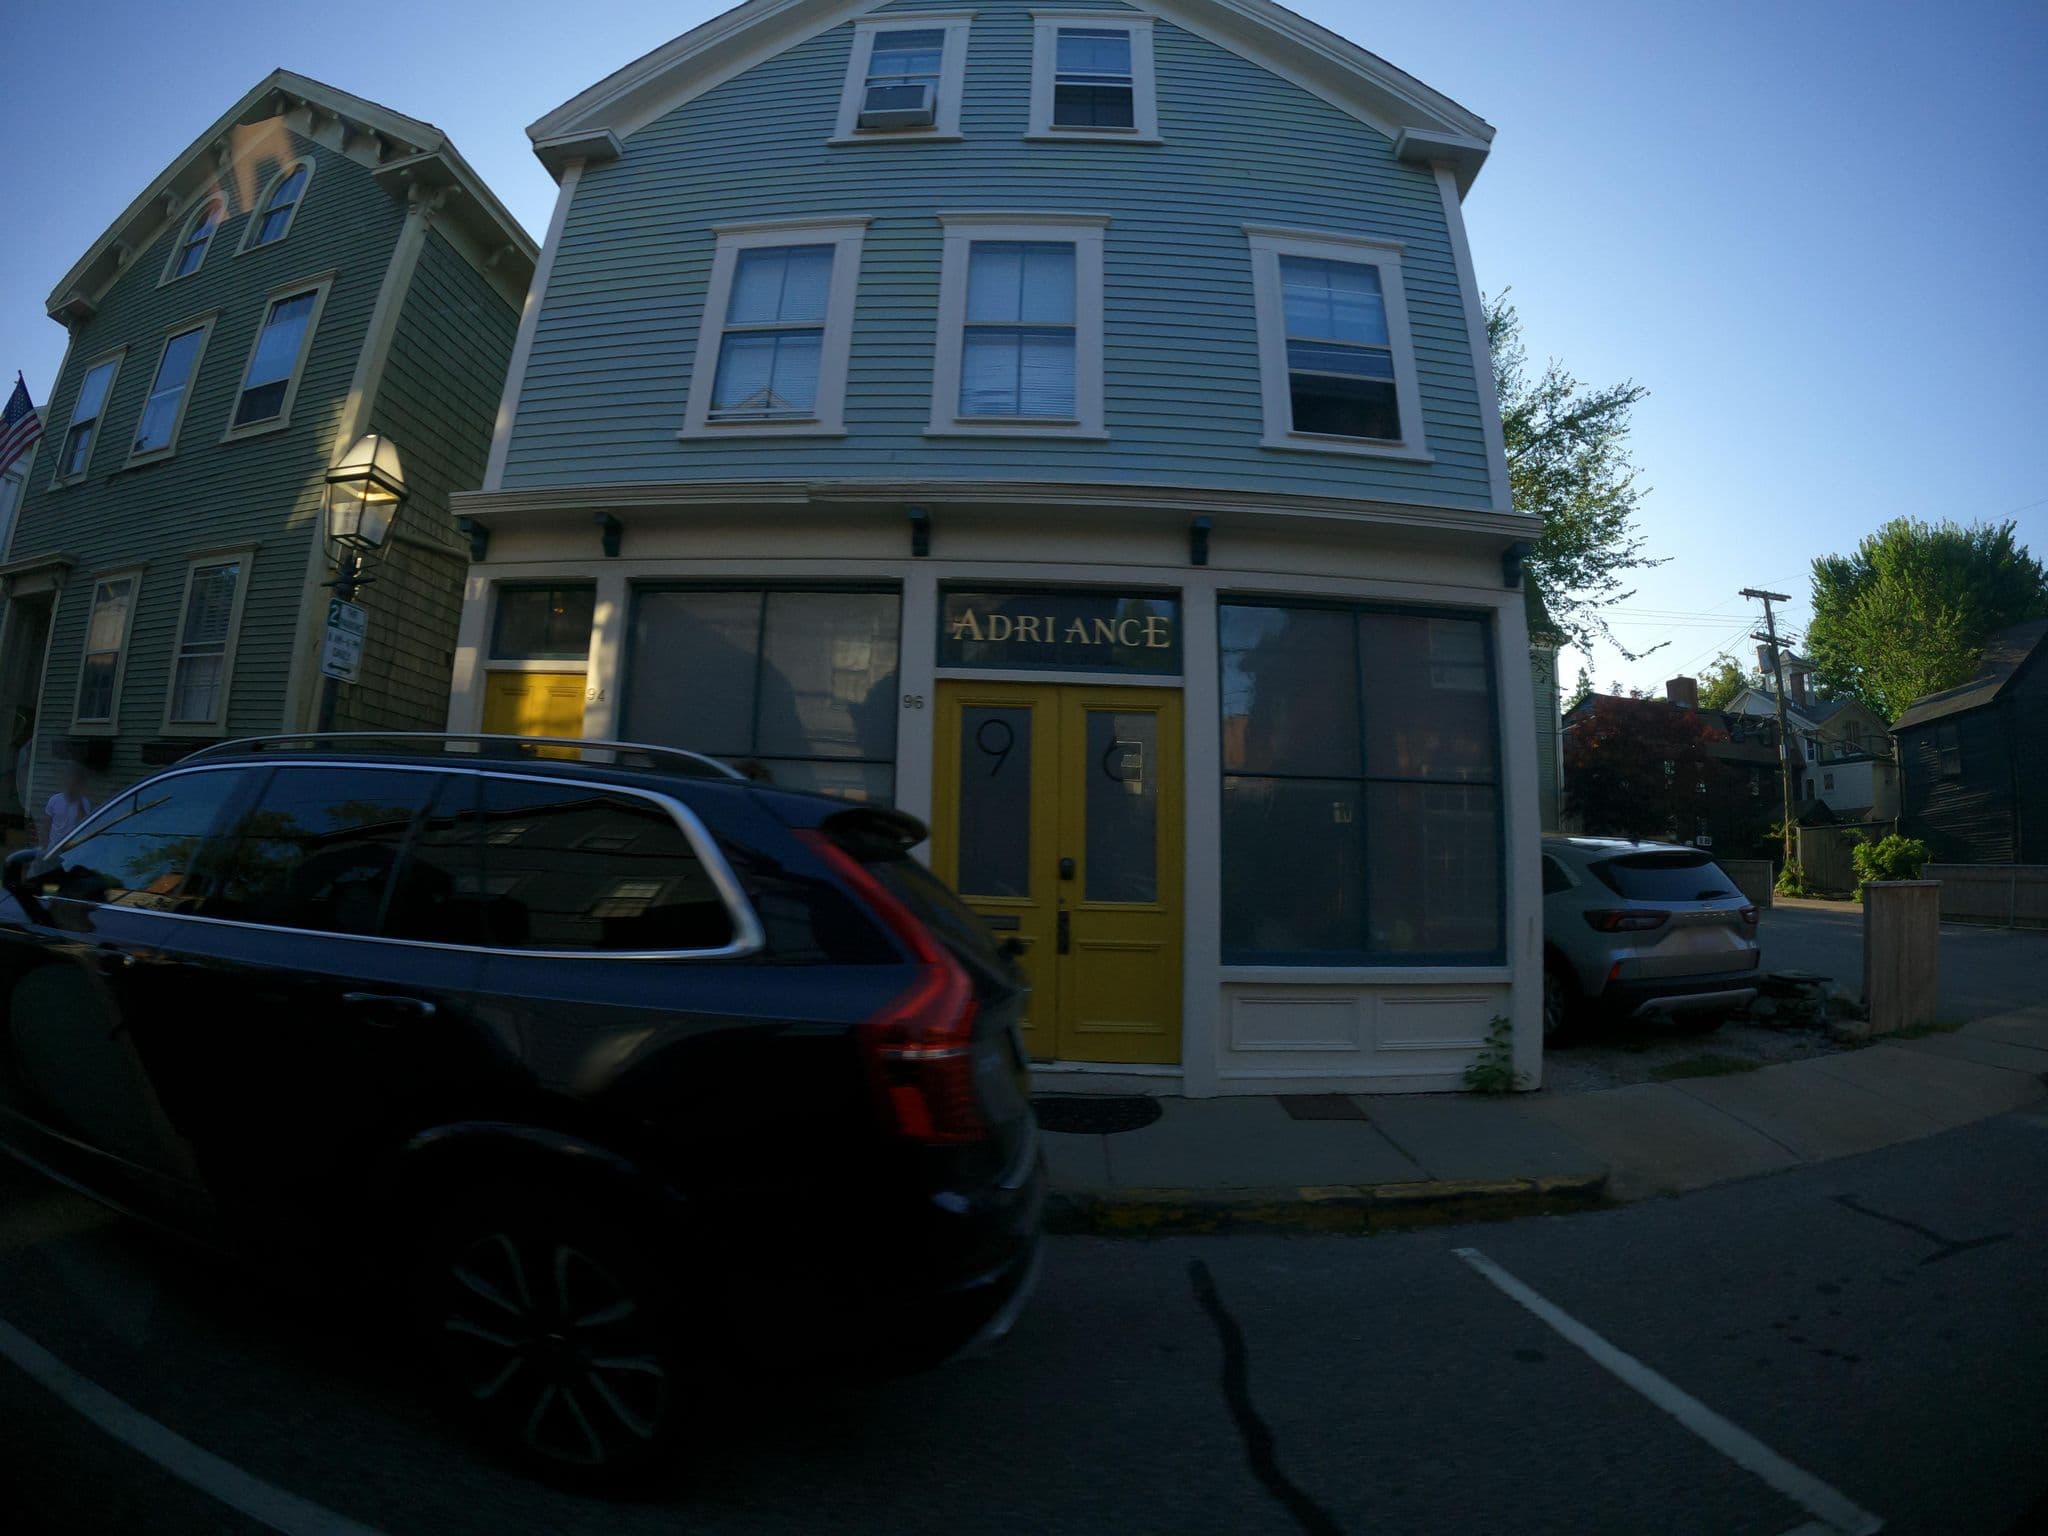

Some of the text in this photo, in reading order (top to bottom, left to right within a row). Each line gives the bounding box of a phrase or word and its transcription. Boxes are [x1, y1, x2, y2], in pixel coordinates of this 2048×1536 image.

[330, 603, 340, 623] 2
[952, 607, 1171, 649] ADRIANCE
[586, 687, 605, 702] 94
[903, 694, 925, 709] 96
[976, 718, 1014, 776] 9
